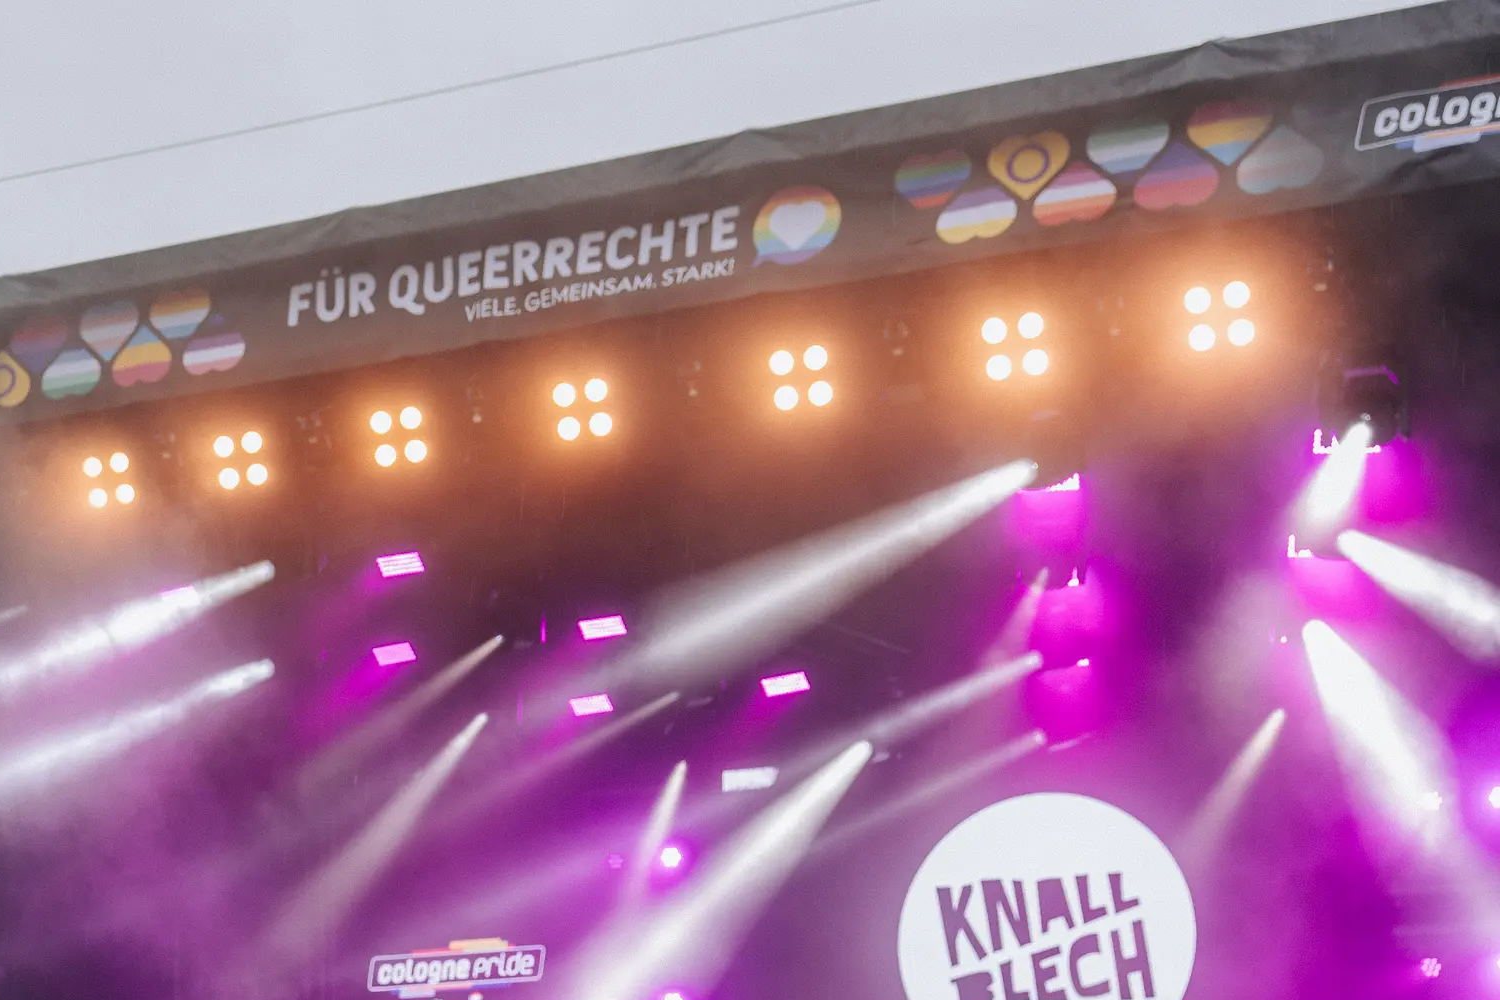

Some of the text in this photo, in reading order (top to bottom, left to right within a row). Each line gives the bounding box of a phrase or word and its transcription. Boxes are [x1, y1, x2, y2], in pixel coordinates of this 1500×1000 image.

[1373, 91, 1500, 137] colog
[287, 206, 741, 327] FÜR QUEERRECHTE
[464, 257, 736, 323] VIELE. GEMEINSAM. STARK!
[936, 873, 1140, 967] KNALL
[377, 952, 536, 985] cologne pride
